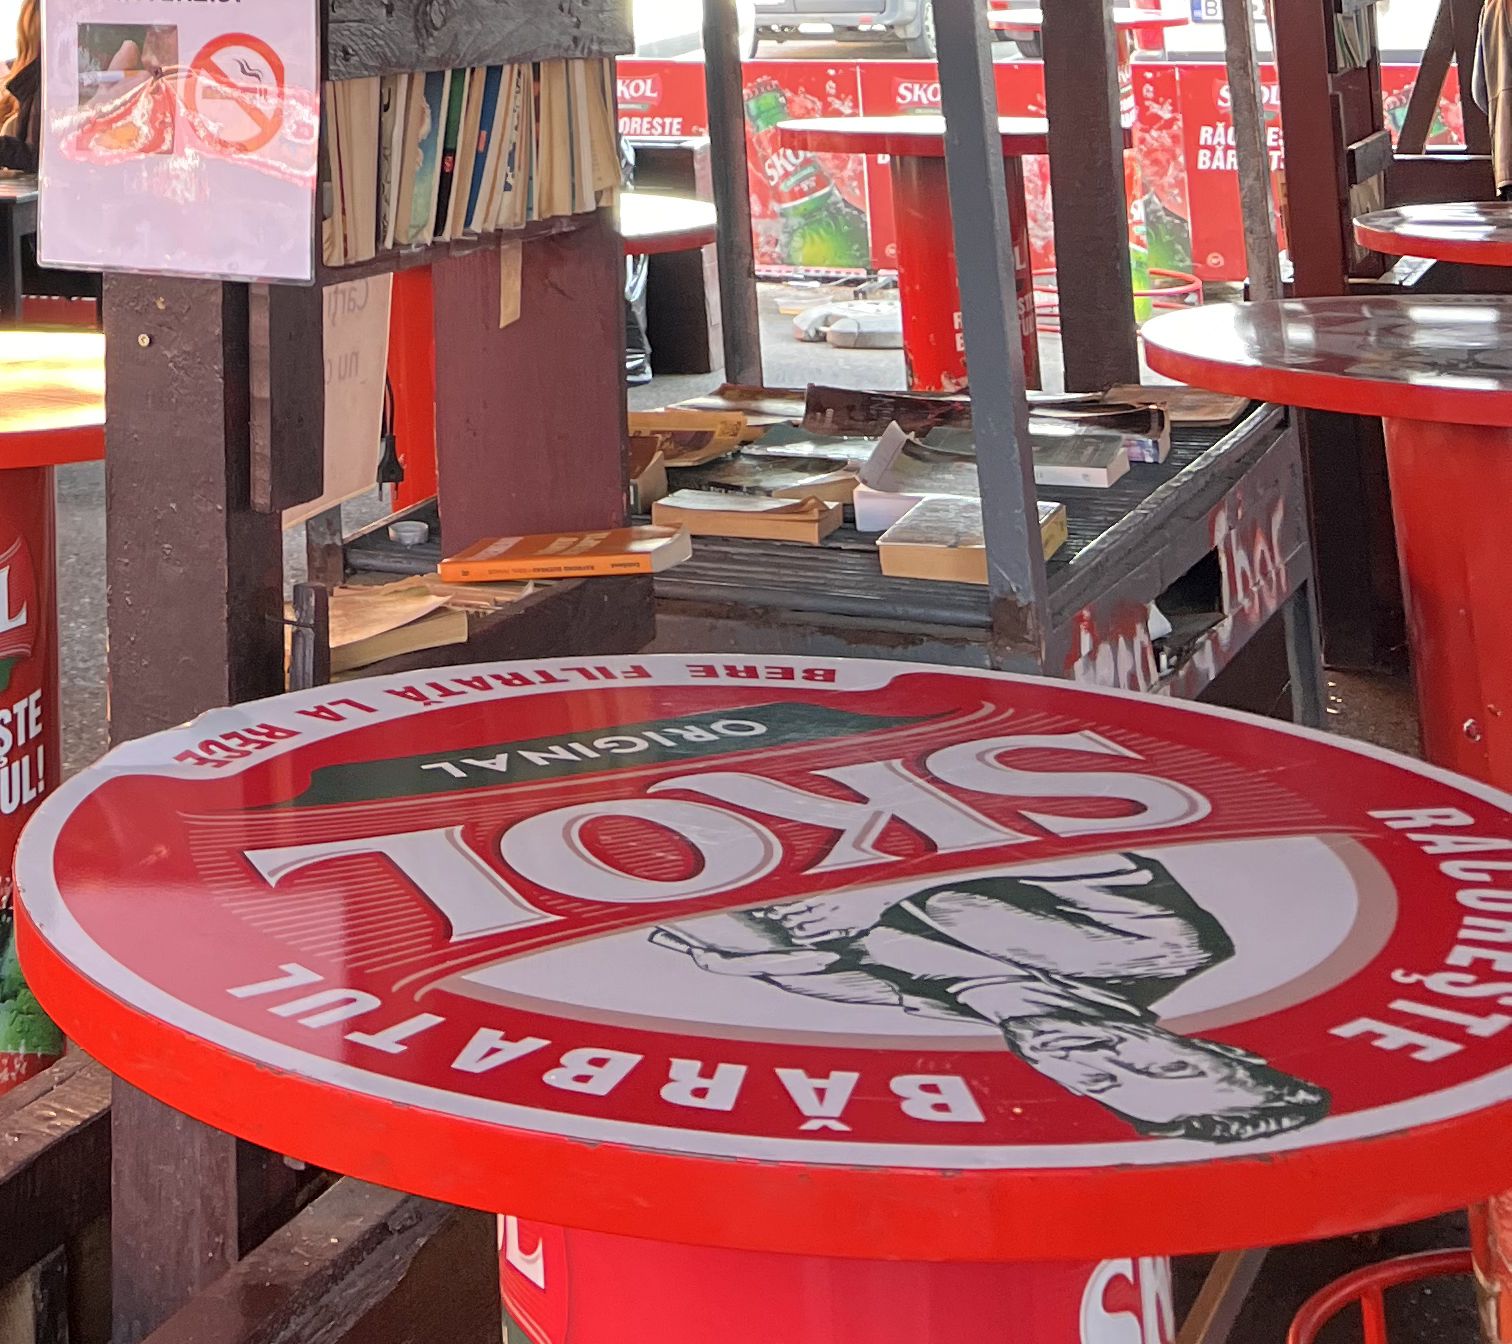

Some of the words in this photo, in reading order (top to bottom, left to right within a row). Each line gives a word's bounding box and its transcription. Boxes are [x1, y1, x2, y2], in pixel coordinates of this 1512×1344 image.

[617, 78, 658, 99] KOL
[896, 82, 942, 104] SKO
[384, 662, 653, 710] FILTRATĂ
[687, 662, 838, 683] BERE
[294, 697, 378, 723] LA
[172, 720, 298, 770] RECE
[419, 716, 769, 780] ORIGINAL
[243, 728, 1214, 942] SKOL
[224, 960, 987, 1132] BĂRBATUL
